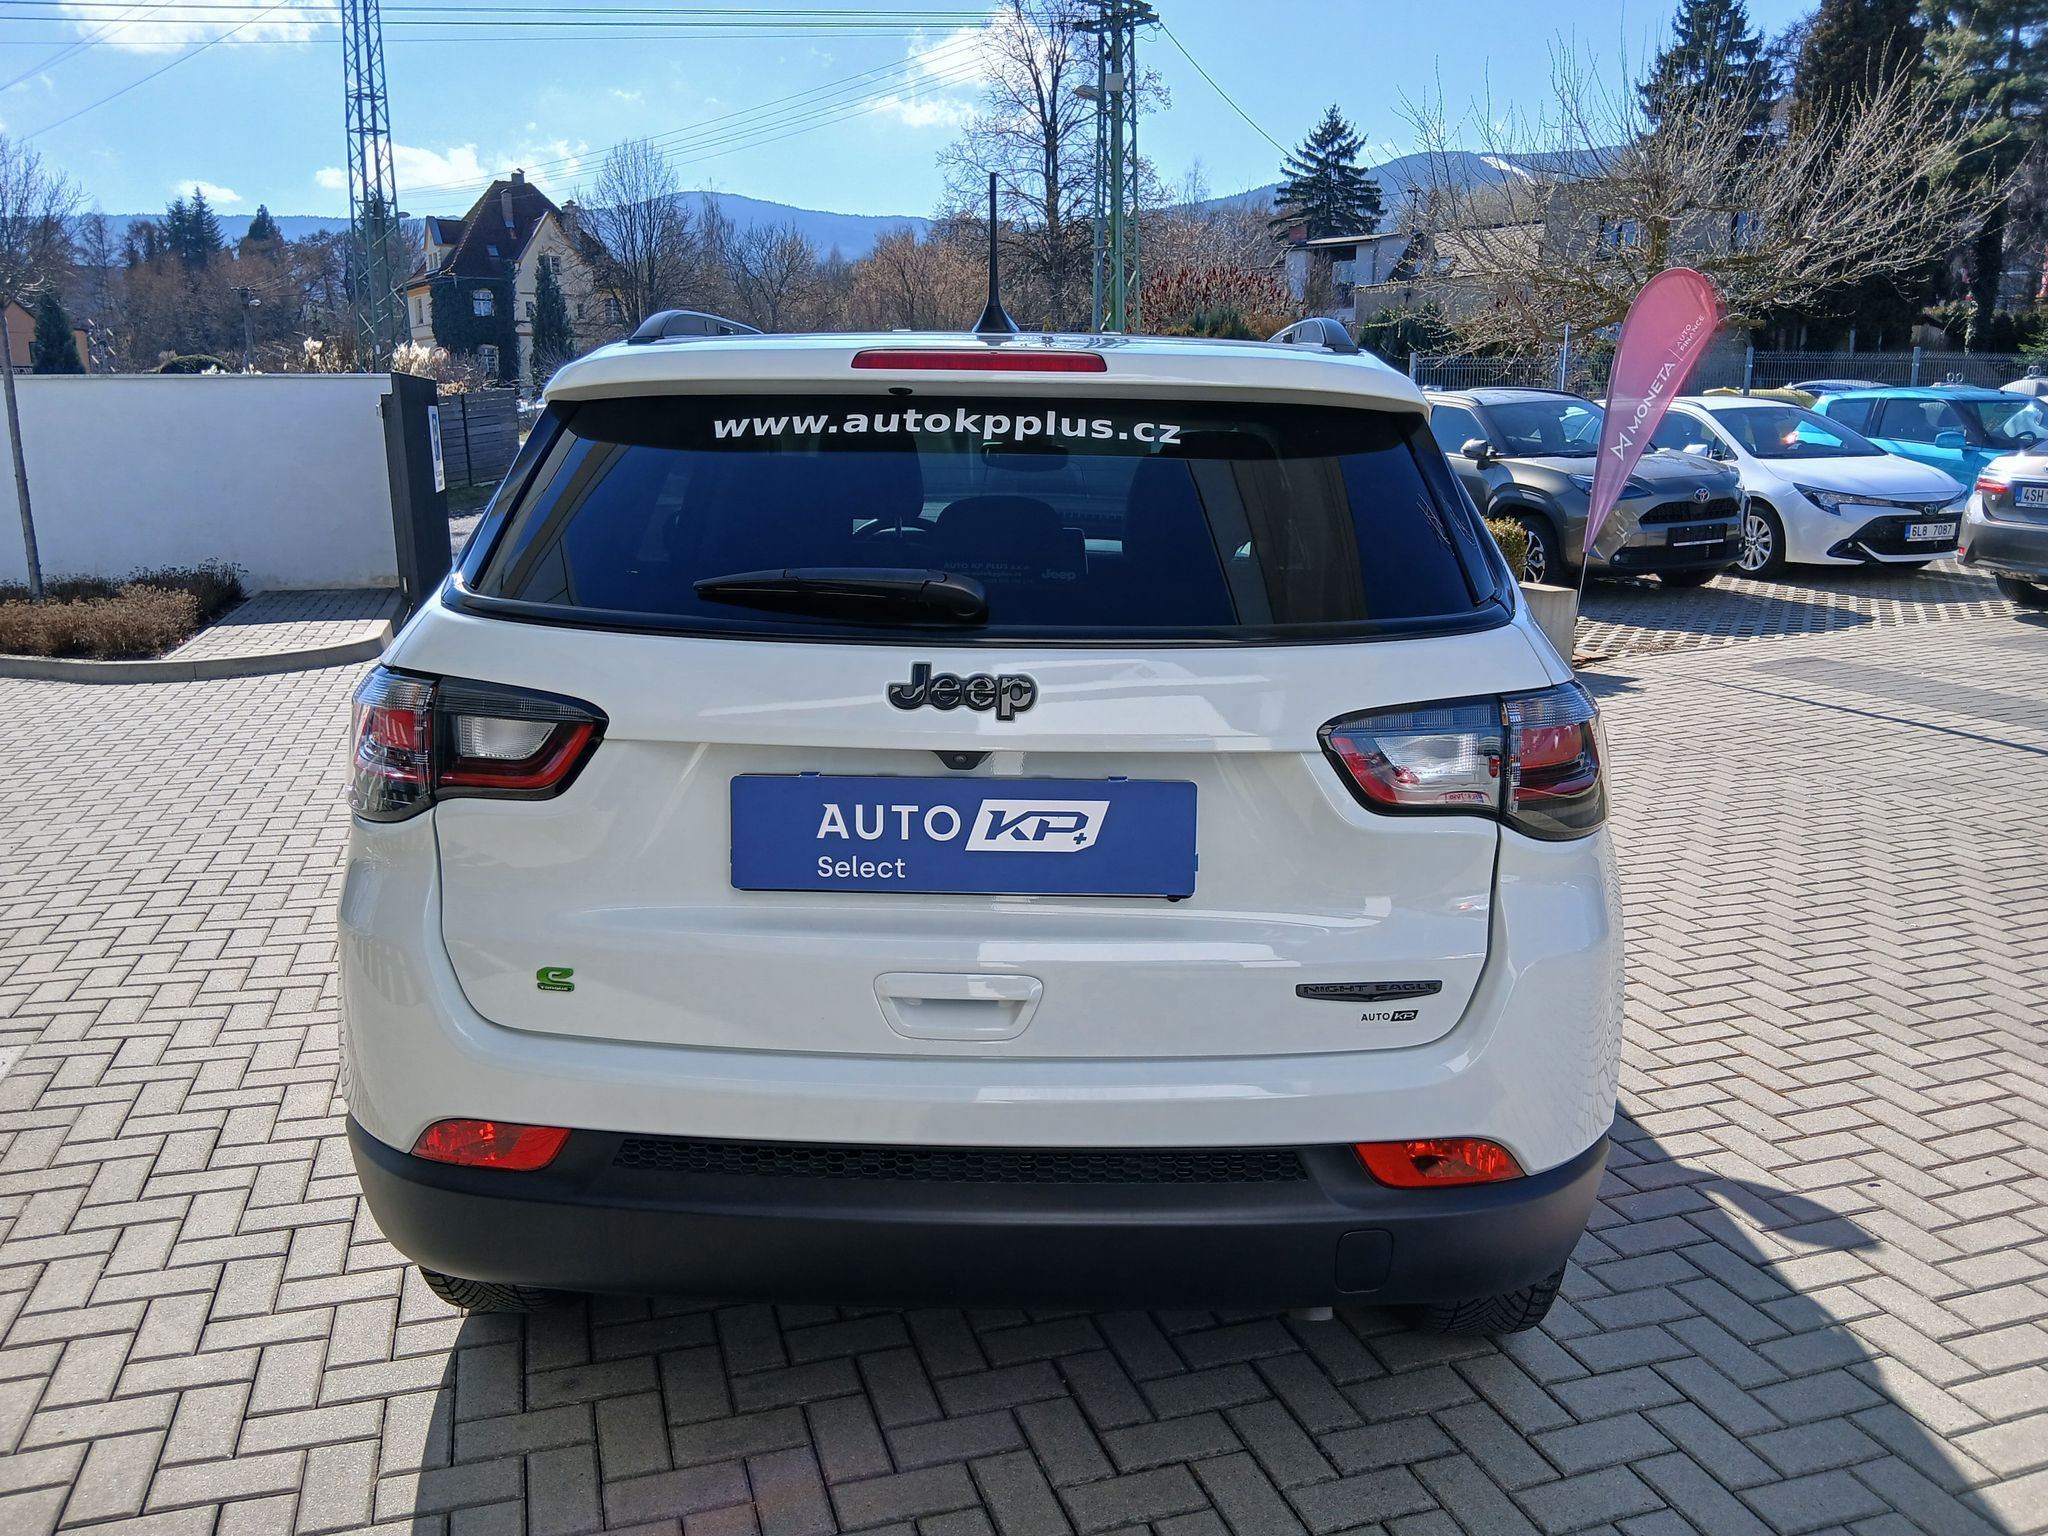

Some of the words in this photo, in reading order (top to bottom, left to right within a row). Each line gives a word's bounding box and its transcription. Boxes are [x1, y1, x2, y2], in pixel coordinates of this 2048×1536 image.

[1676, 324, 1692, 348] AUTO
[1680, 315, 1705, 351] FINANCE
[1627, 362, 1676, 435] MONETA
[713, 408, 1182, 445] www.autokpplus.cz
[1933, 524, 1953, 536] 7087
[1041, 568, 1076, 582] Jeep
[888, 662, 1038, 721] Jeep
[816, 803, 961, 841] AUTO
[816, 855, 907, 880] Select
[1303, 984, 1369, 995] NIGHT
[1375, 982, 1439, 992] EAGLE
[1361, 1012, 1390, 1021] AUTO
